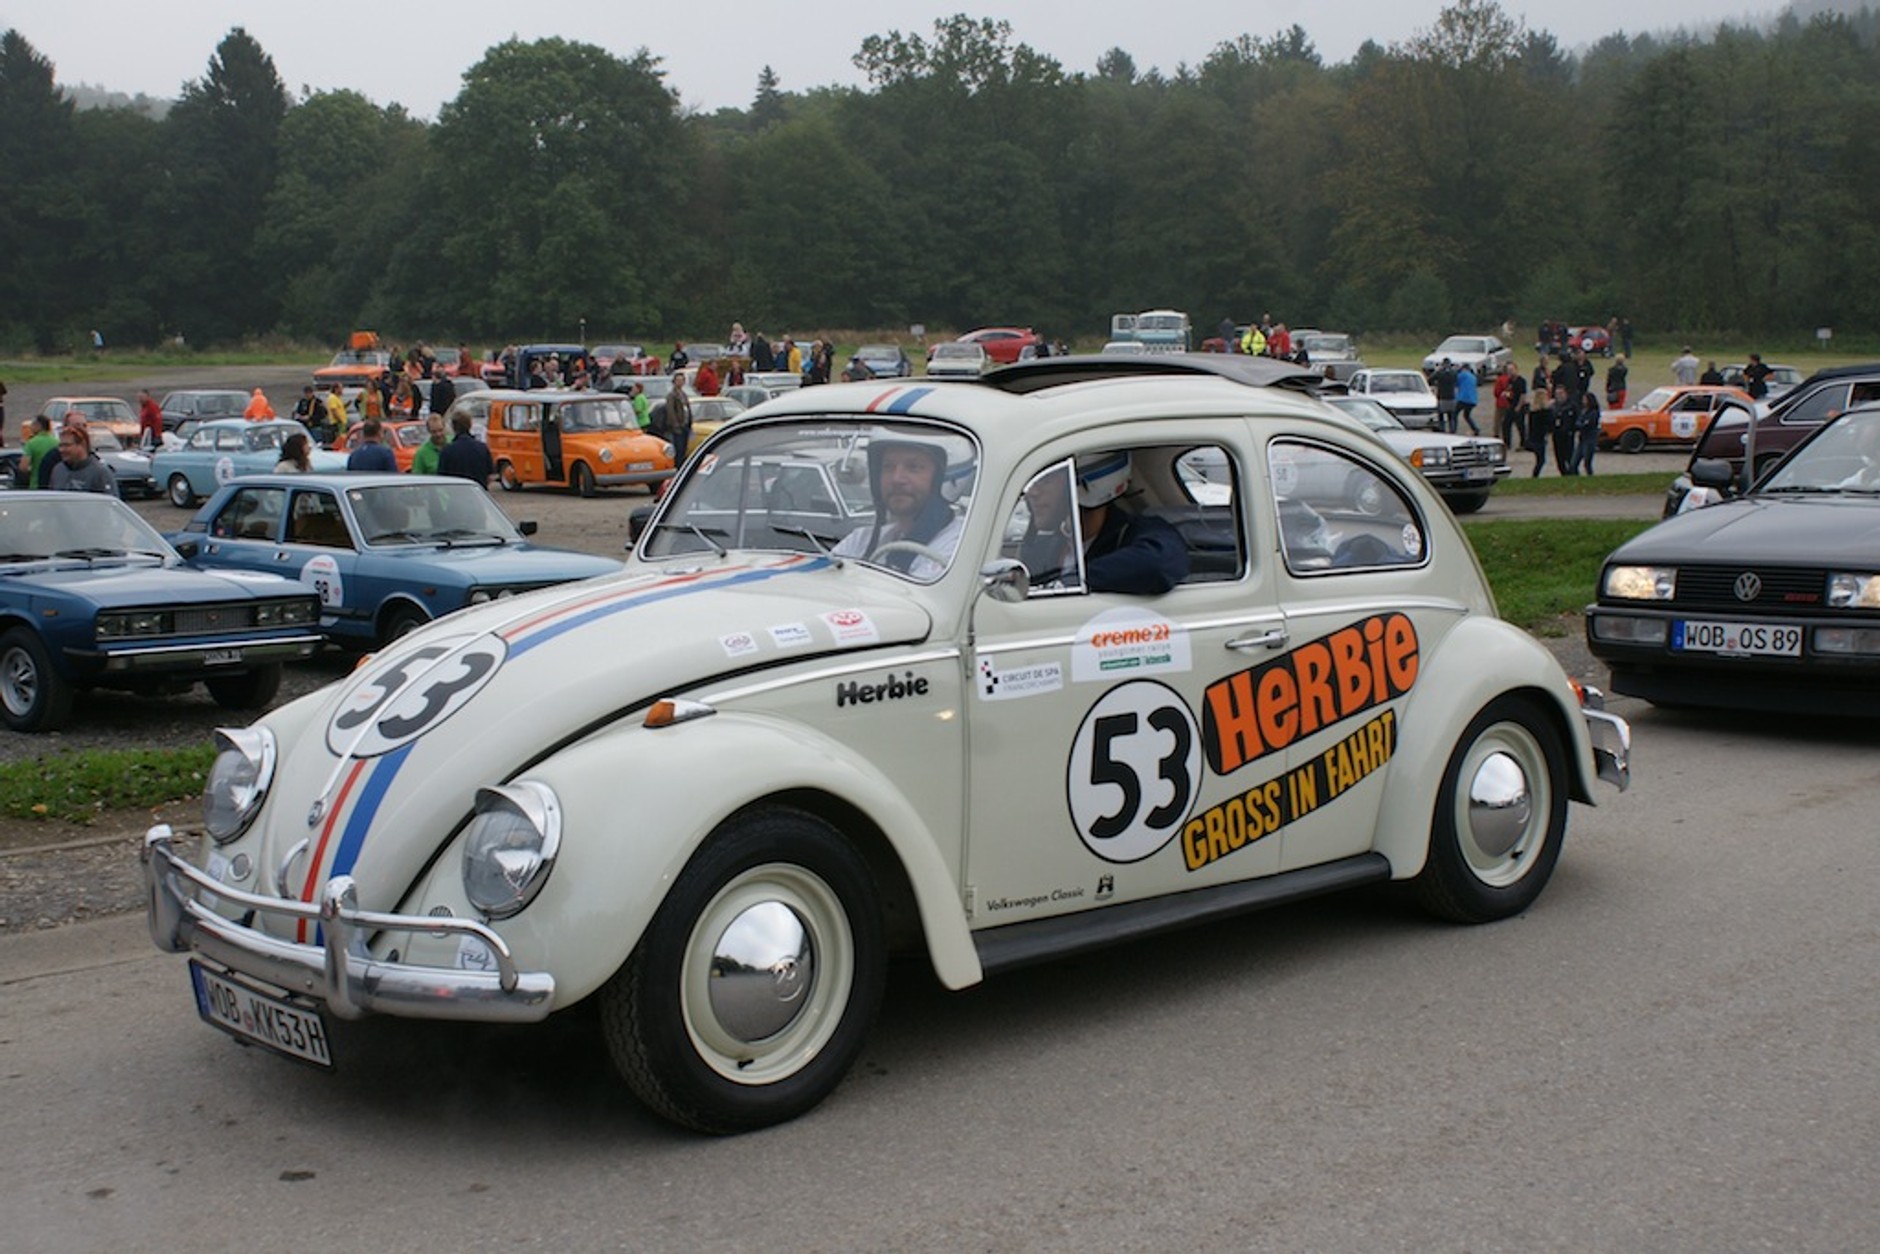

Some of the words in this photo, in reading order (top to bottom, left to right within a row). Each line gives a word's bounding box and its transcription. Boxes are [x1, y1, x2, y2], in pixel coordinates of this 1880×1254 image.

[1685, 624, 1726, 648] WOB
[1740, 627, 1768, 650] OS
[1772, 629, 1799, 652] 89
[336, 647, 496, 740] 53
[837, 671, 929, 708] Herbie
[1002, 671, 1032, 683] CIRCUIT
[1033, 669, 1044, 679] DE
[1044, 667, 1060, 677] SPA
[1089, 706, 1192, 839] 53
[1183, 780, 1281, 872] GROSS
[1288, 763, 1318, 821] IN
[1324, 710, 1394, 799] FAHRT
[987, 895, 1050, 911] Volkswagen
[1051, 886, 1085, 901] Classic
[203, 974, 241, 1024] WOB
